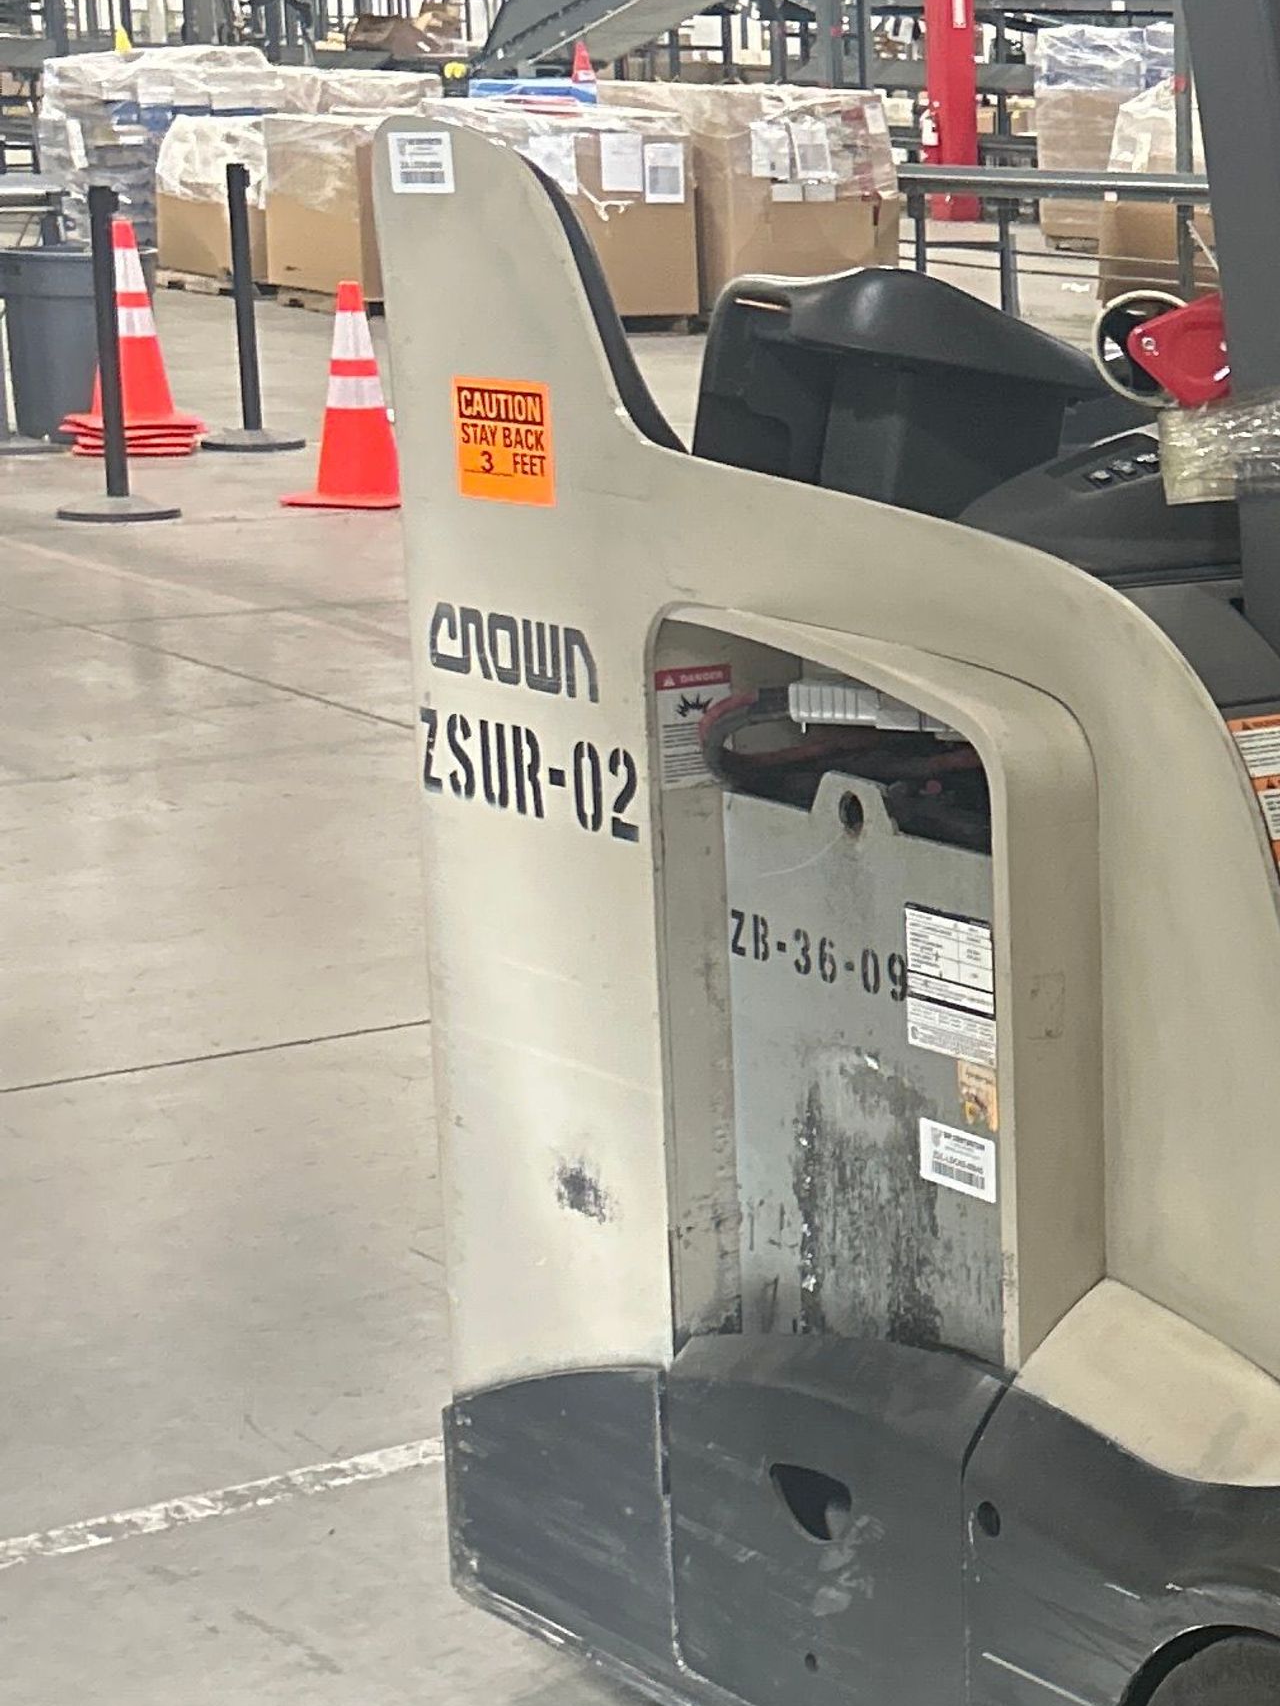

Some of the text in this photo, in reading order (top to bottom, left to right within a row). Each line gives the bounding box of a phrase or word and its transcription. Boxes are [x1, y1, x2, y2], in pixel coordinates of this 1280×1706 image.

[458, 388, 543, 425] CAUTION
[460, 421, 545, 452] STAY BACK
[512, 452, 546, 478] FEET
[429, 602, 600, 704] CROWN
[419, 708, 642, 842] ZSUR-02
[730, 909, 909, 1003] ZB-36-09
